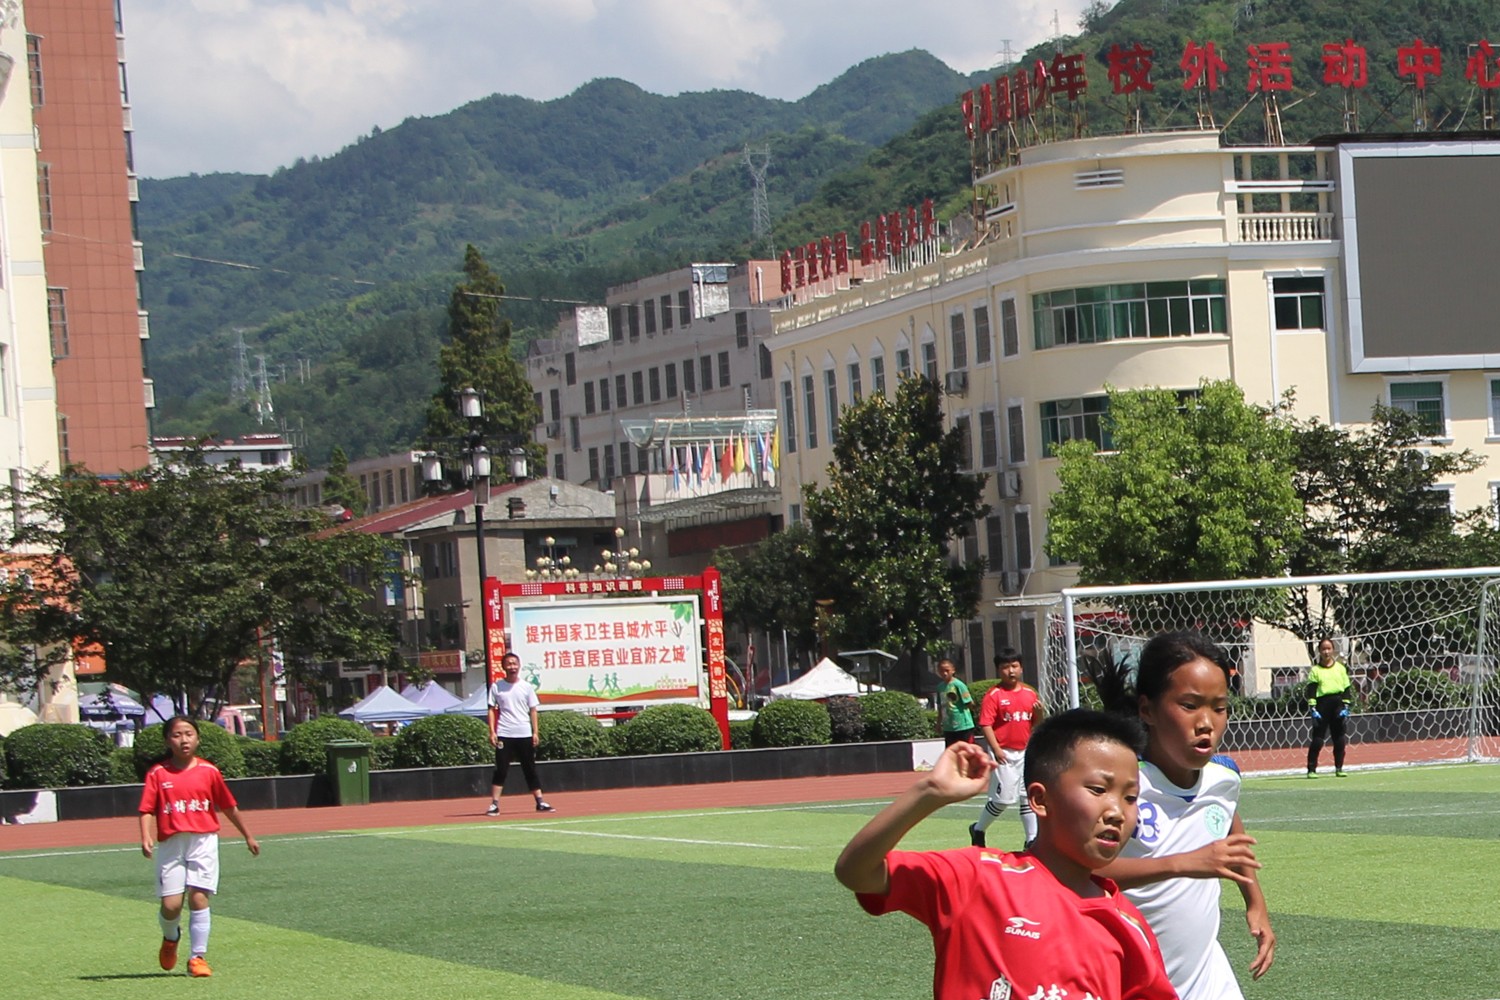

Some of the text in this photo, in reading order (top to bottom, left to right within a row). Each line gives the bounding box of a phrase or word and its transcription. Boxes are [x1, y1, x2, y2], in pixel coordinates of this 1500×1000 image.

[565, 580, 643, 593] 科普知识画廊
[526, 620, 669, 644] 提升国家卫生县城水平
[543, 645, 687, 670] 打造宜居宜业宜游之城
[1004, 926, 1041, 940] SUNAIS
